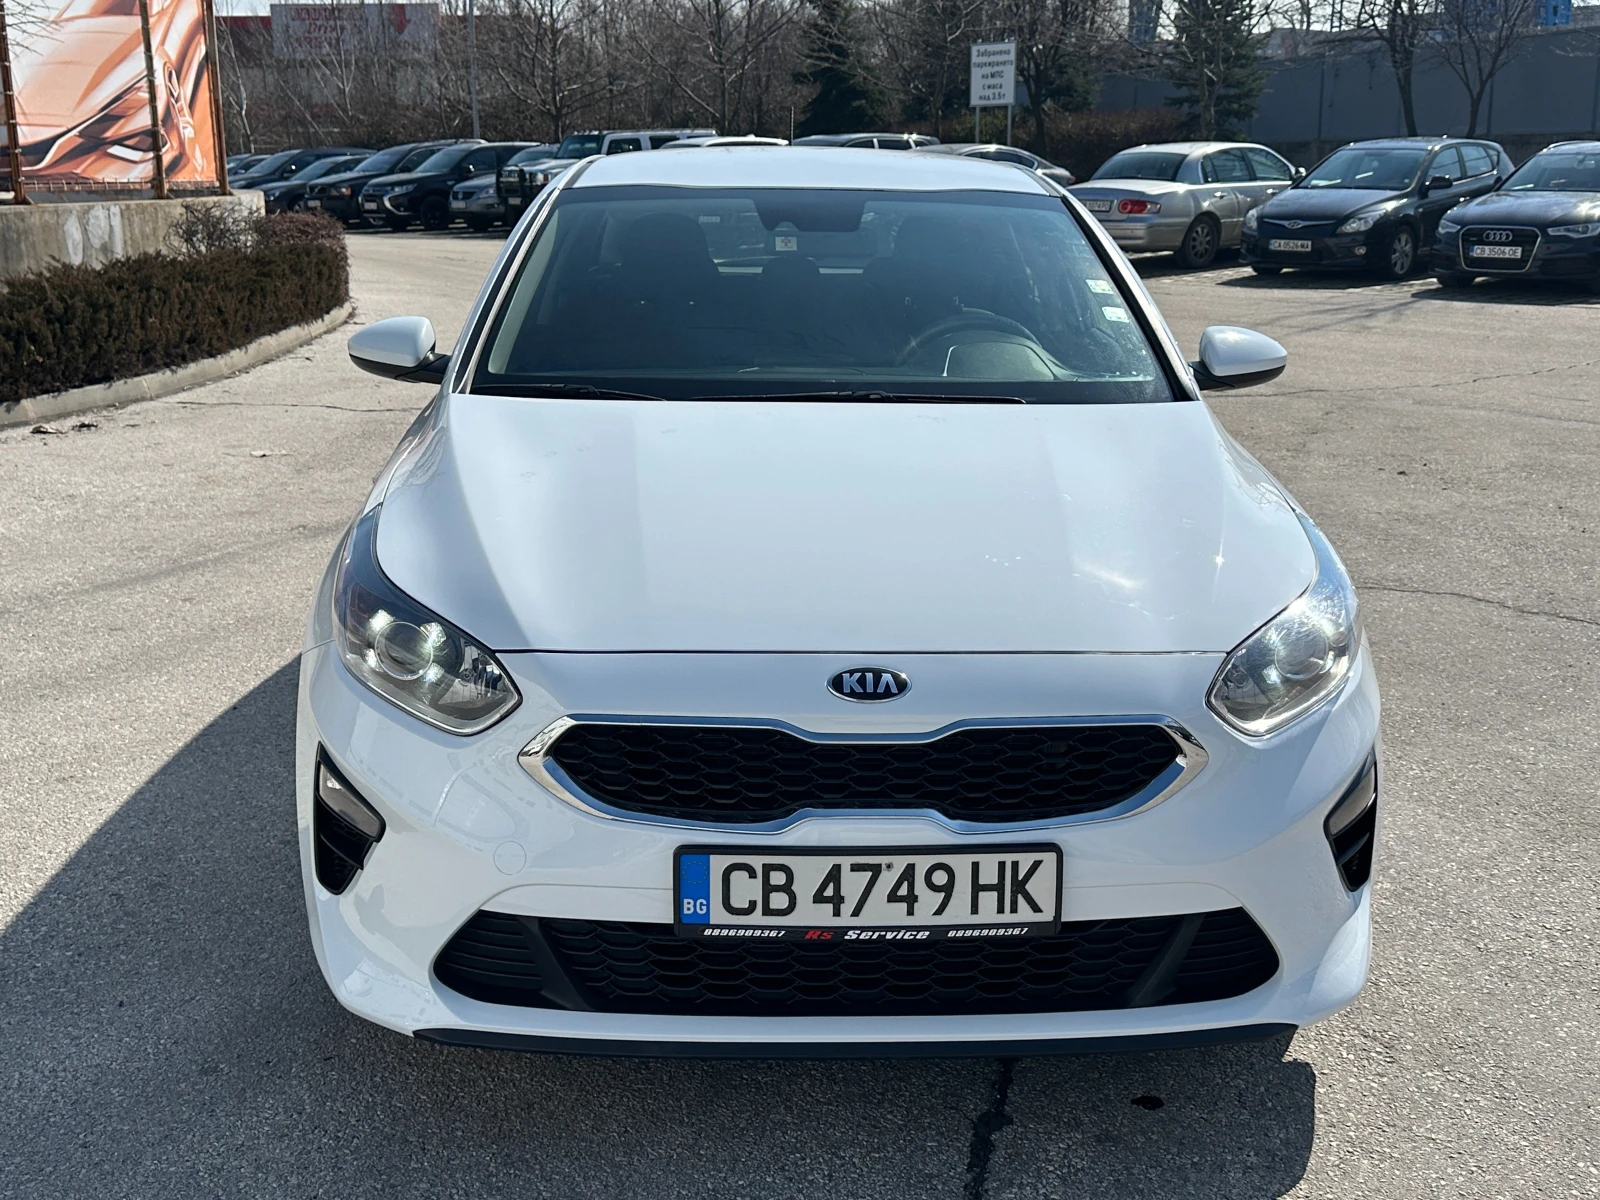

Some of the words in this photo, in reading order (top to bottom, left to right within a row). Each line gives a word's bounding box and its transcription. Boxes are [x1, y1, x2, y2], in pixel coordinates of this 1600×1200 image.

[990, 70, 1004, 79] МПС
[1487, 247, 1507, 256] 3506
[842, 672, 898, 693] KIA
[721, 862, 797, 917] CB
[812, 861, 956, 918] 4749
[970, 859, 1044, 916] HK
[683, 898, 707, 914] BG
[703, 928, 786, 938] 0896909367
[805, 930, 834, 939] Rs
[843, 930, 930, 940] Service
[947, 927, 1029, 938] 0896909367
